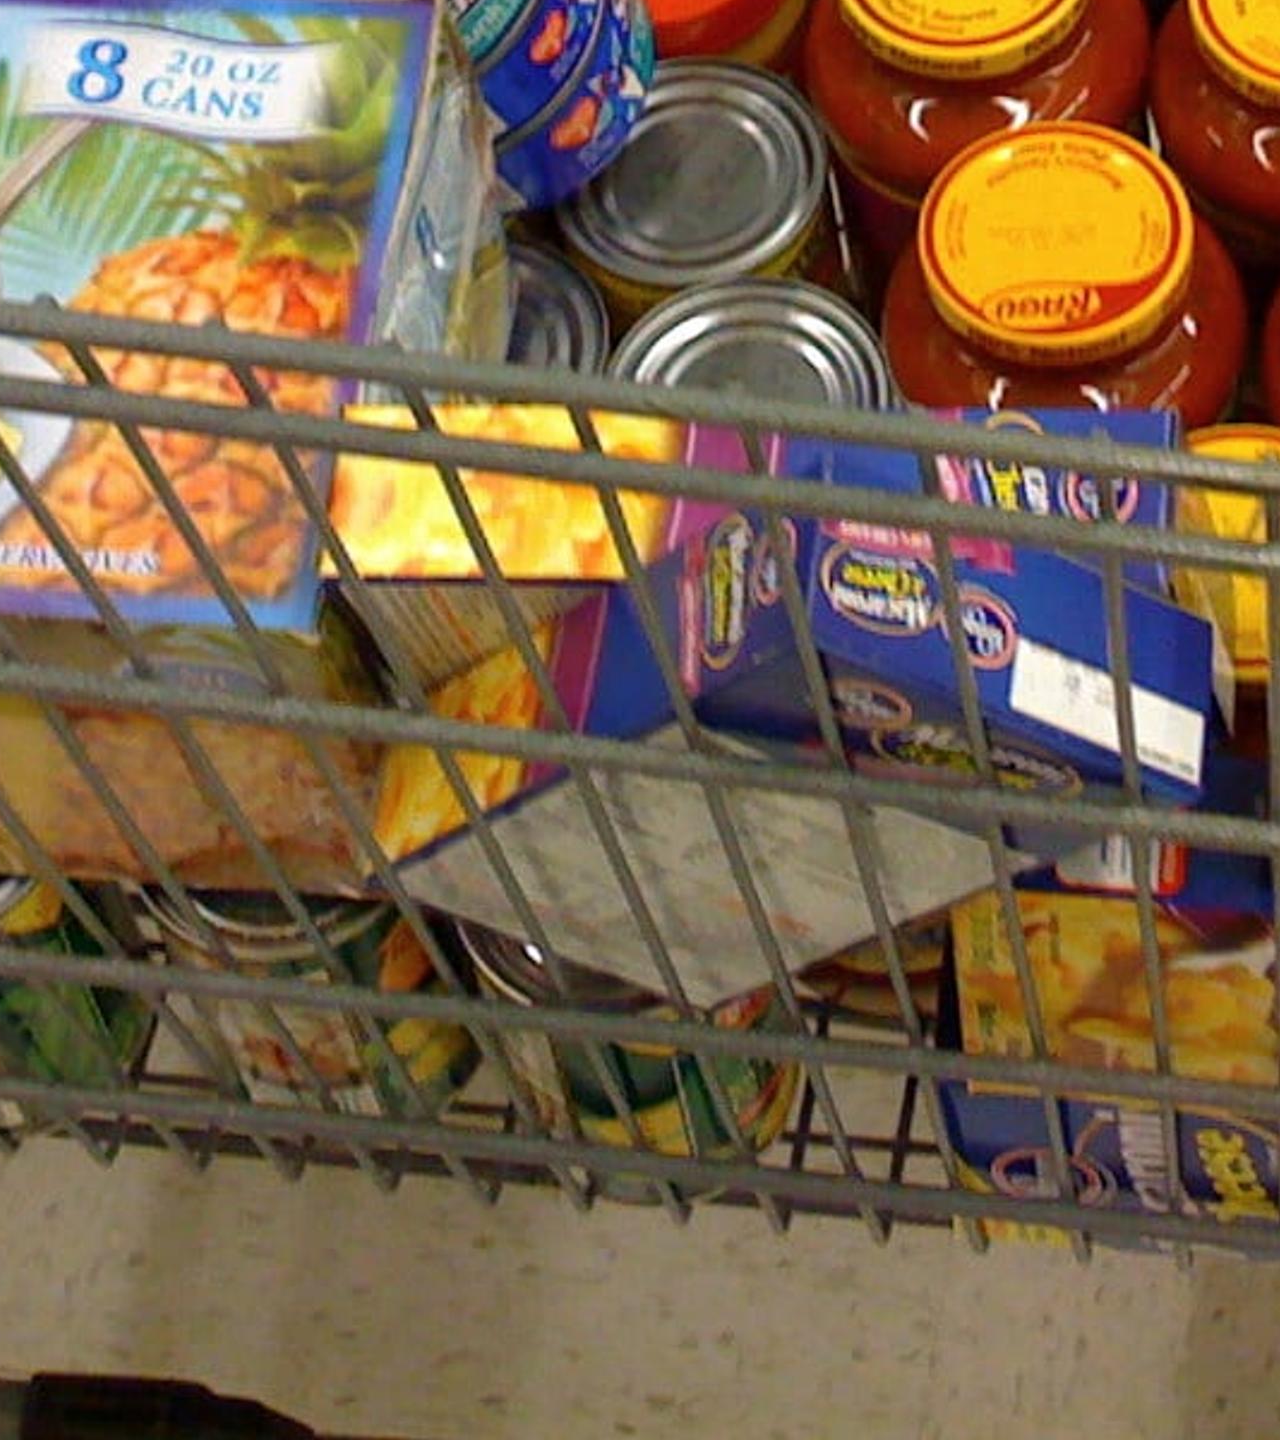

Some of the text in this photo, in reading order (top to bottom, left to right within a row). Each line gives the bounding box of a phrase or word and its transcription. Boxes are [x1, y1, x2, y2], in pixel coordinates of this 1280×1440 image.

[66, 37, 130, 104] 8
[166, 48, 284, 87] 20 OZ
[140, 76, 267, 120] CANS
